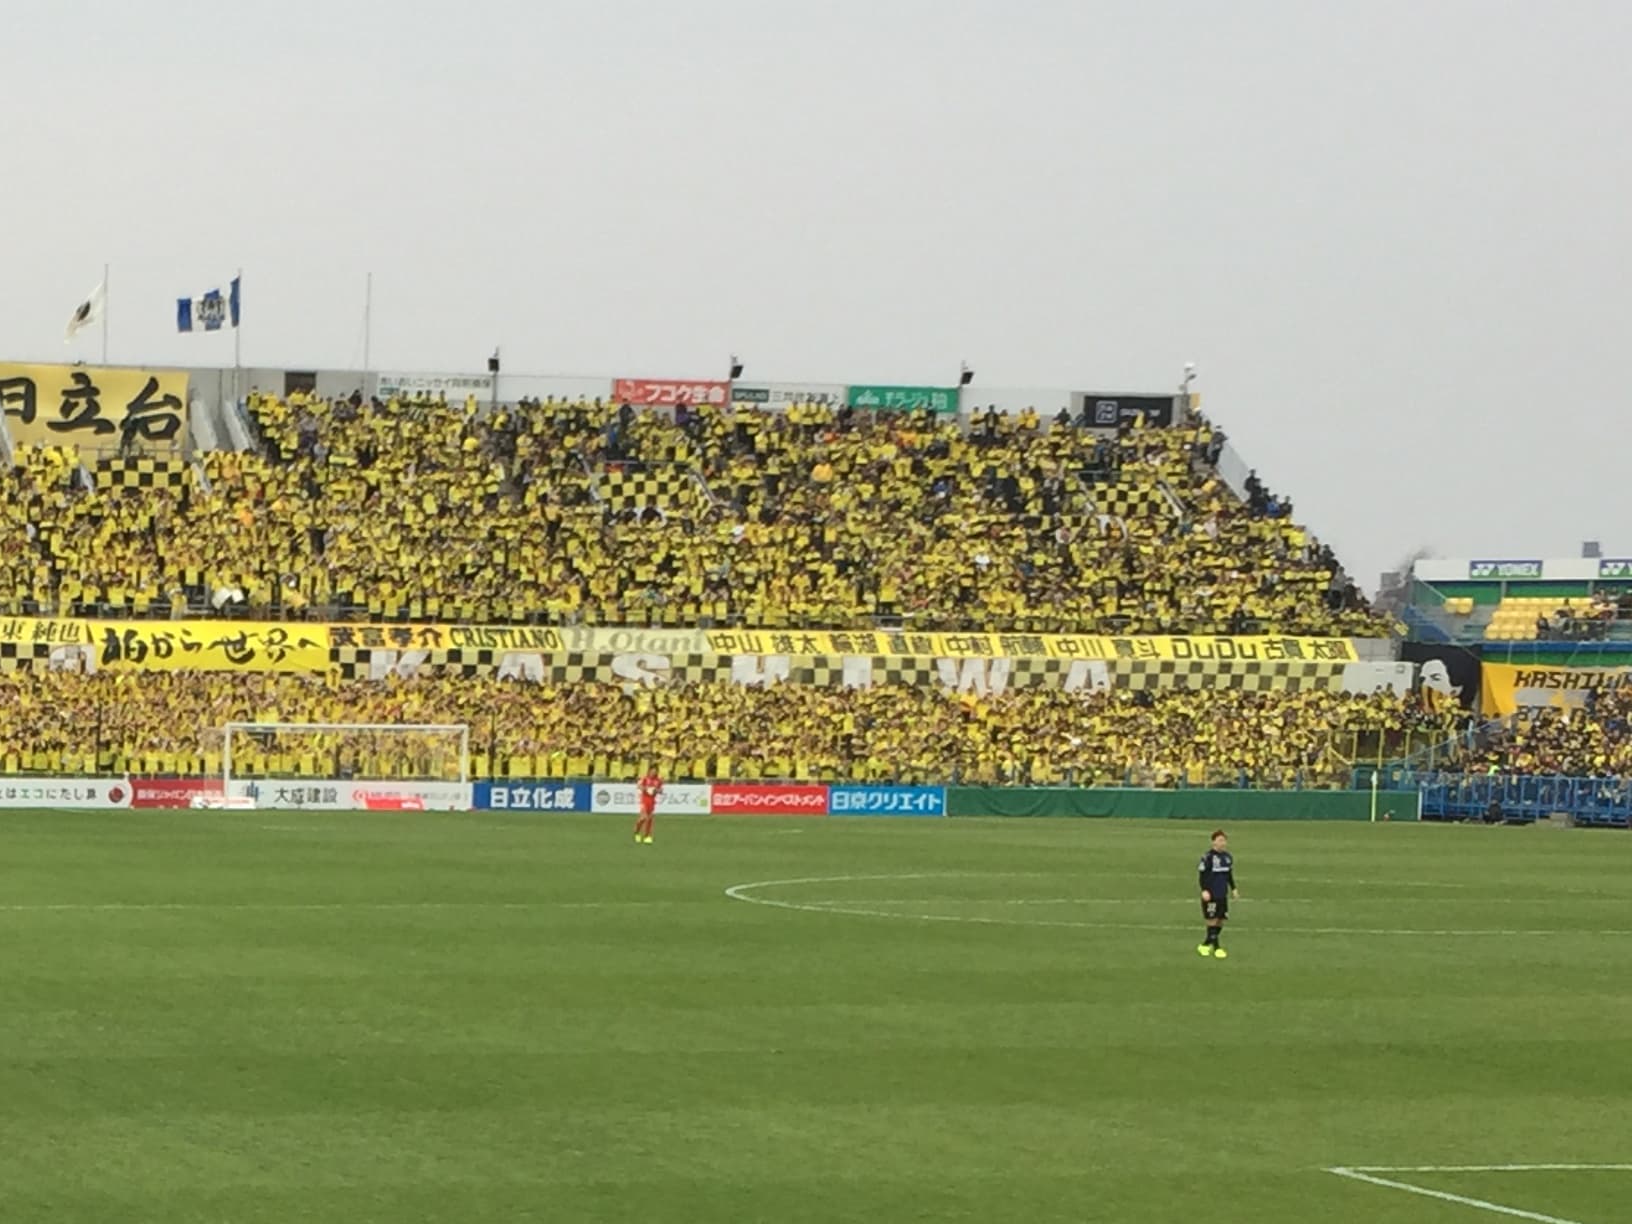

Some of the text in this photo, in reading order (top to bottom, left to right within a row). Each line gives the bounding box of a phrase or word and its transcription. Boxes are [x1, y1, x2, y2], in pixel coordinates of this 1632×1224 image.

[449, 627, 560, 650] CRISTIANO
[274, 787, 338, 804] 大成建設
[490, 787, 576, 809] 日立化成
